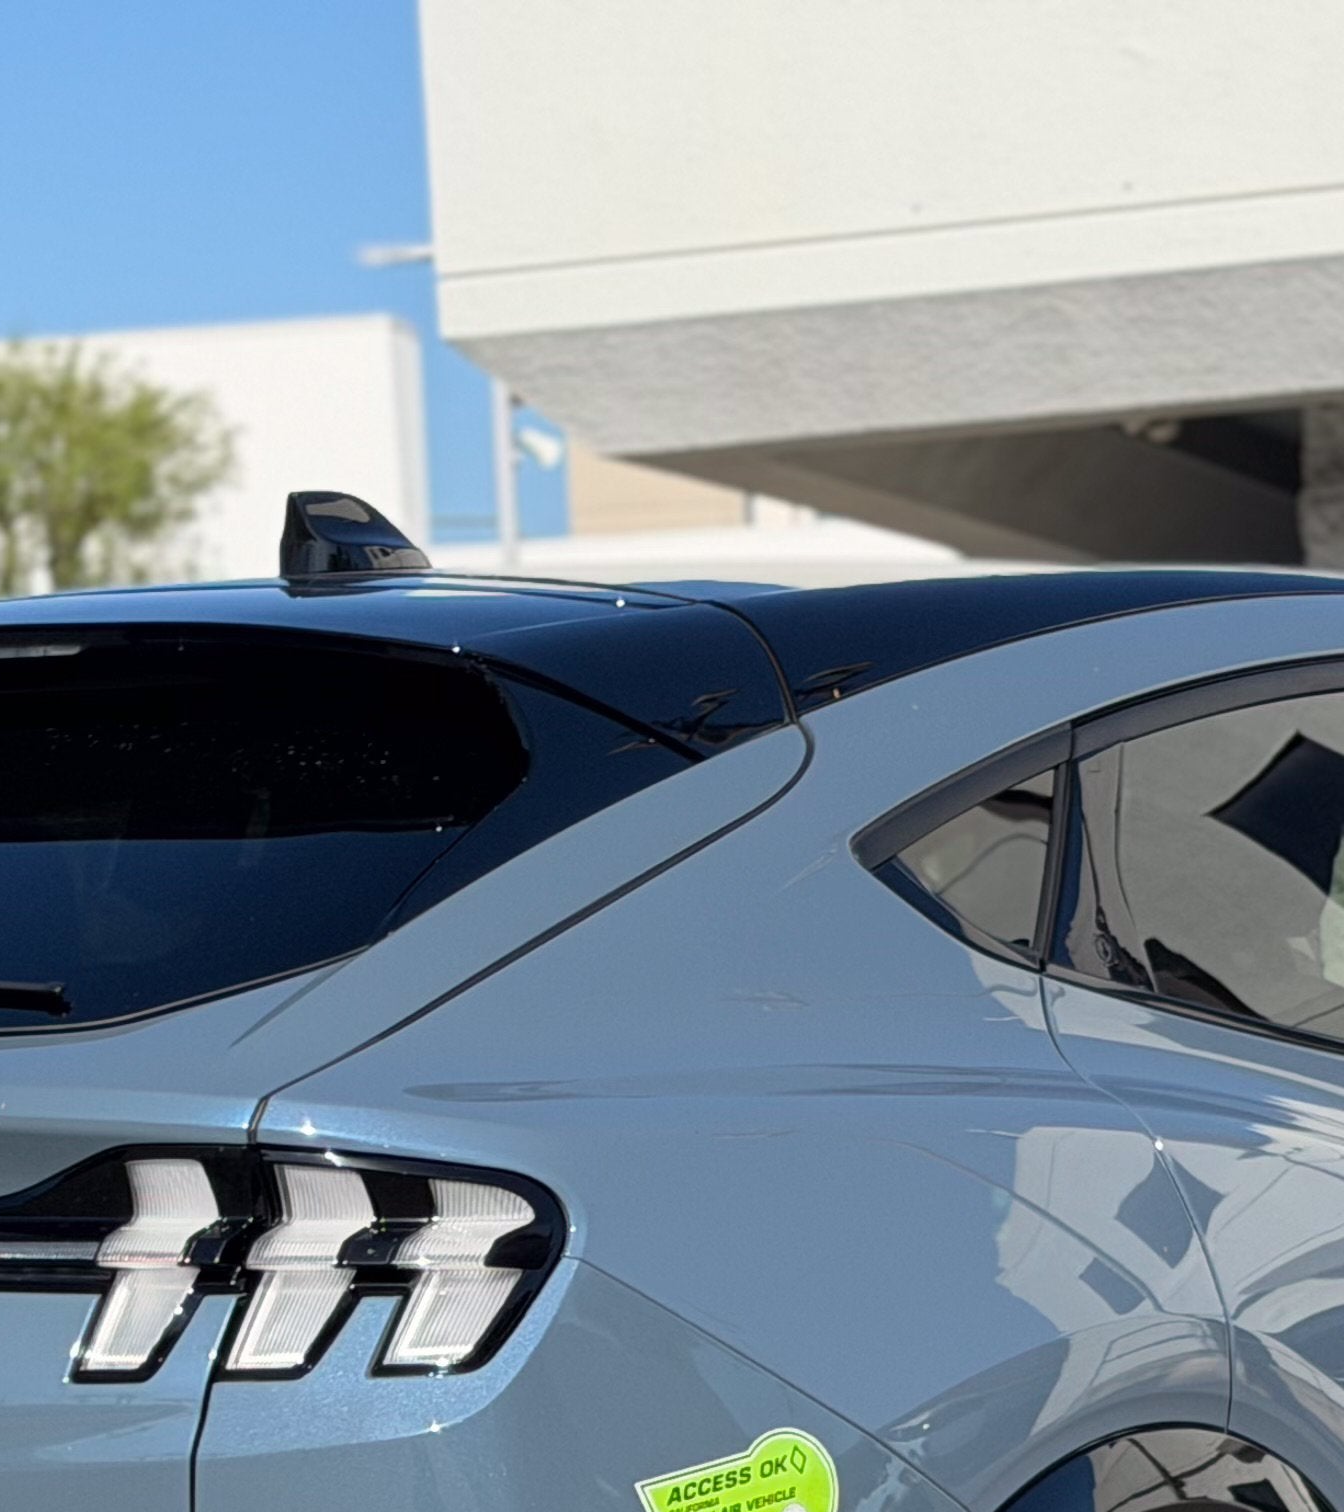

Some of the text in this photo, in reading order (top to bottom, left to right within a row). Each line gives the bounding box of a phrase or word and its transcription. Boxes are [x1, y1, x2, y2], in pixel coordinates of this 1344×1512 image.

[667, 1455, 788, 1506] ACCESS OK
[746, 1487, 797, 1511] VEHICLE
